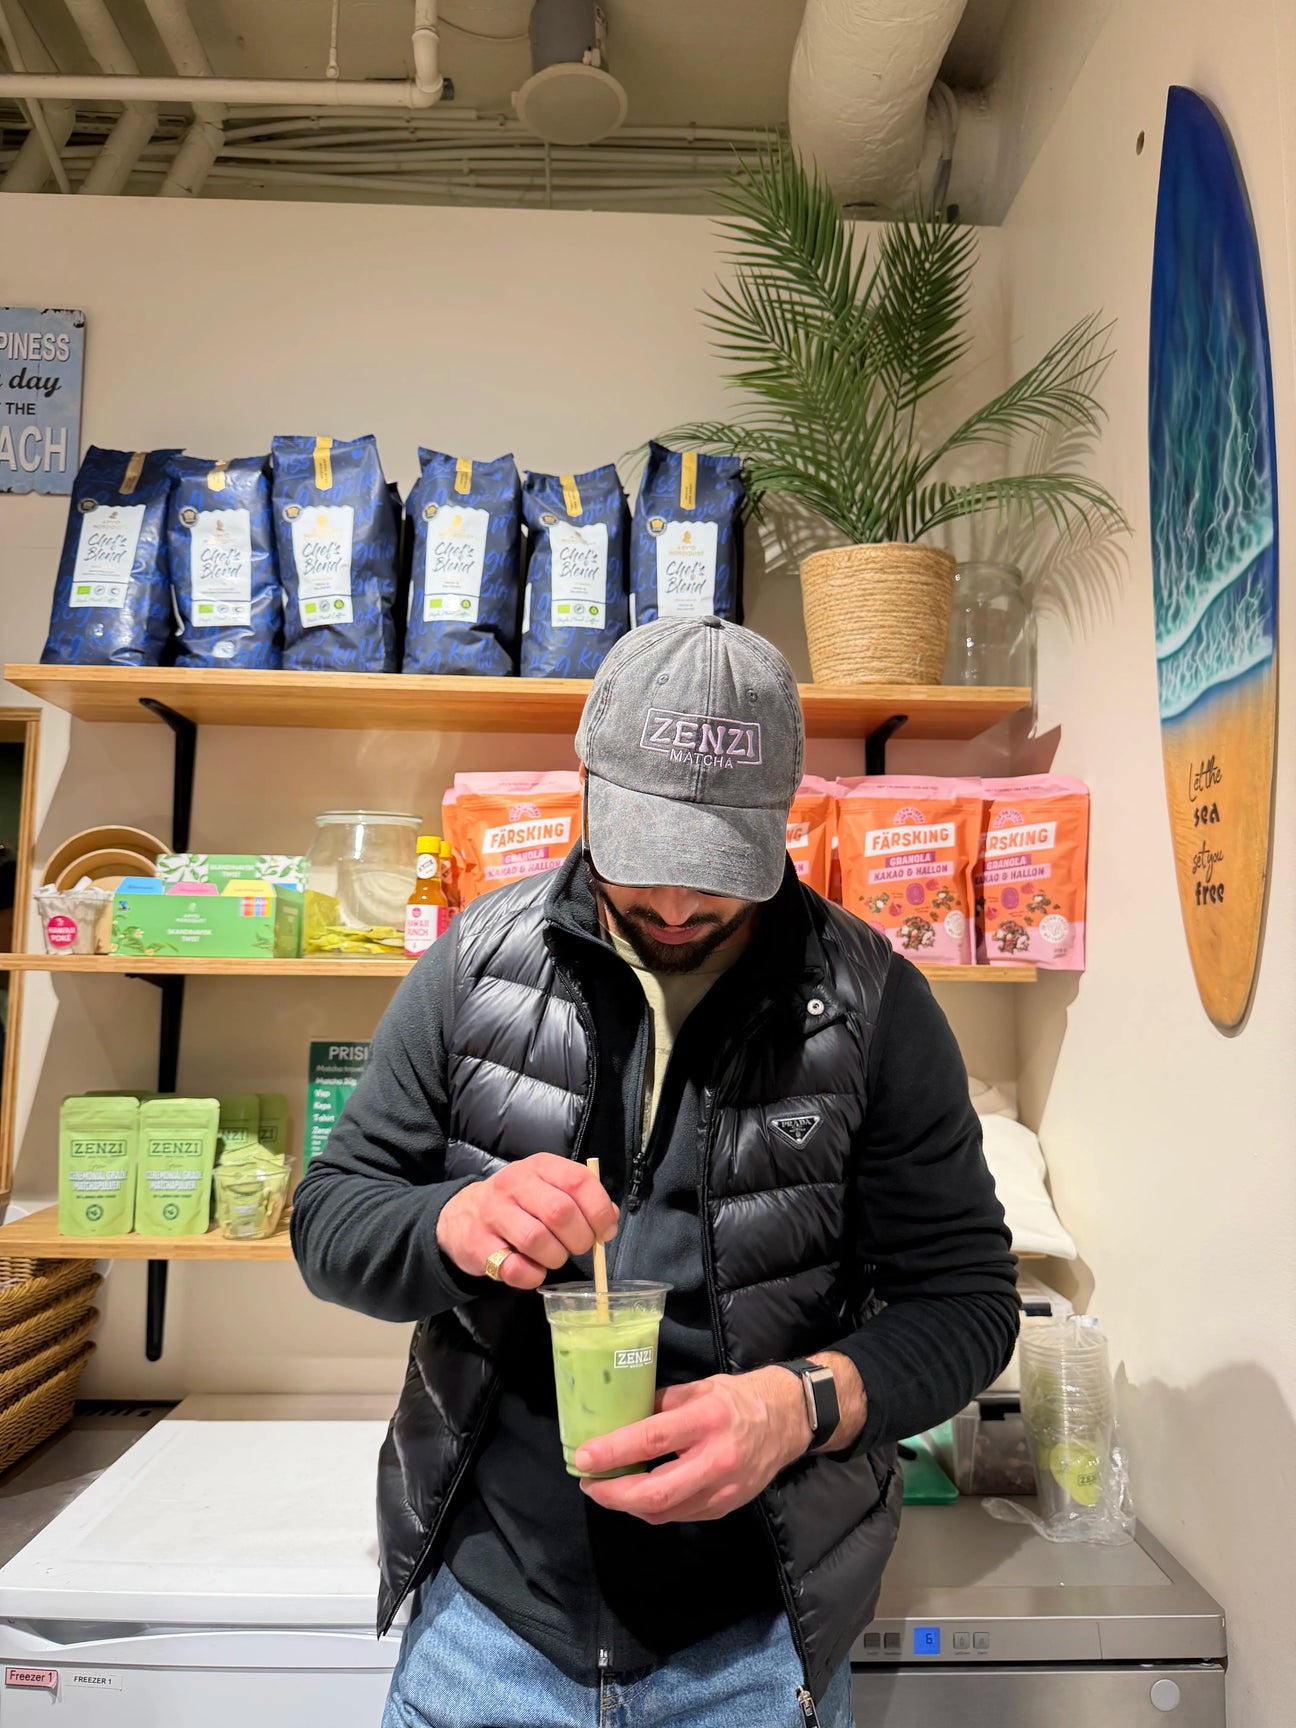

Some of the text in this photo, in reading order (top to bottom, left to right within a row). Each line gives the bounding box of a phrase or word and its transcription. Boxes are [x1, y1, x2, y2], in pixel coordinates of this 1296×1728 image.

[9, 367, 62, 397] day
[6, 403, 36, 415] THE
[0, 425, 68, 473] ACH
[650, 717, 756, 758] ZENZI
[670, 748, 734, 768] MATCHA
[1189, 755, 1222, 802] Let the
[1194, 802, 1220, 827] sea
[490, 822, 565, 848] FÄRSKING
[872, 828, 949, 850] FÄRSKING
[984, 828, 1048, 850] RSKING
[889, 853, 932, 867] GRANOLA
[986, 855, 1027, 870] GRANOLA
[1192, 840, 1223, 883] set you
[873, 869, 904, 881] KAKAO
[916, 864, 948, 876] HALLON
[1011, 867, 1045, 880] HALLON
[1195, 881, 1224, 906] free
[781, 1119, 812, 1127] PRADA
[74, 1142, 123, 1154] ZENZI
[152, 1142, 198, 1154] ZENZI
[618, 1350, 652, 1365] ZENZI
[925, 1633, 933, 1645] 6
[9, 1670, 52, 1682] Freezer 1
[74, 1676, 107, 1684] FREEZER
